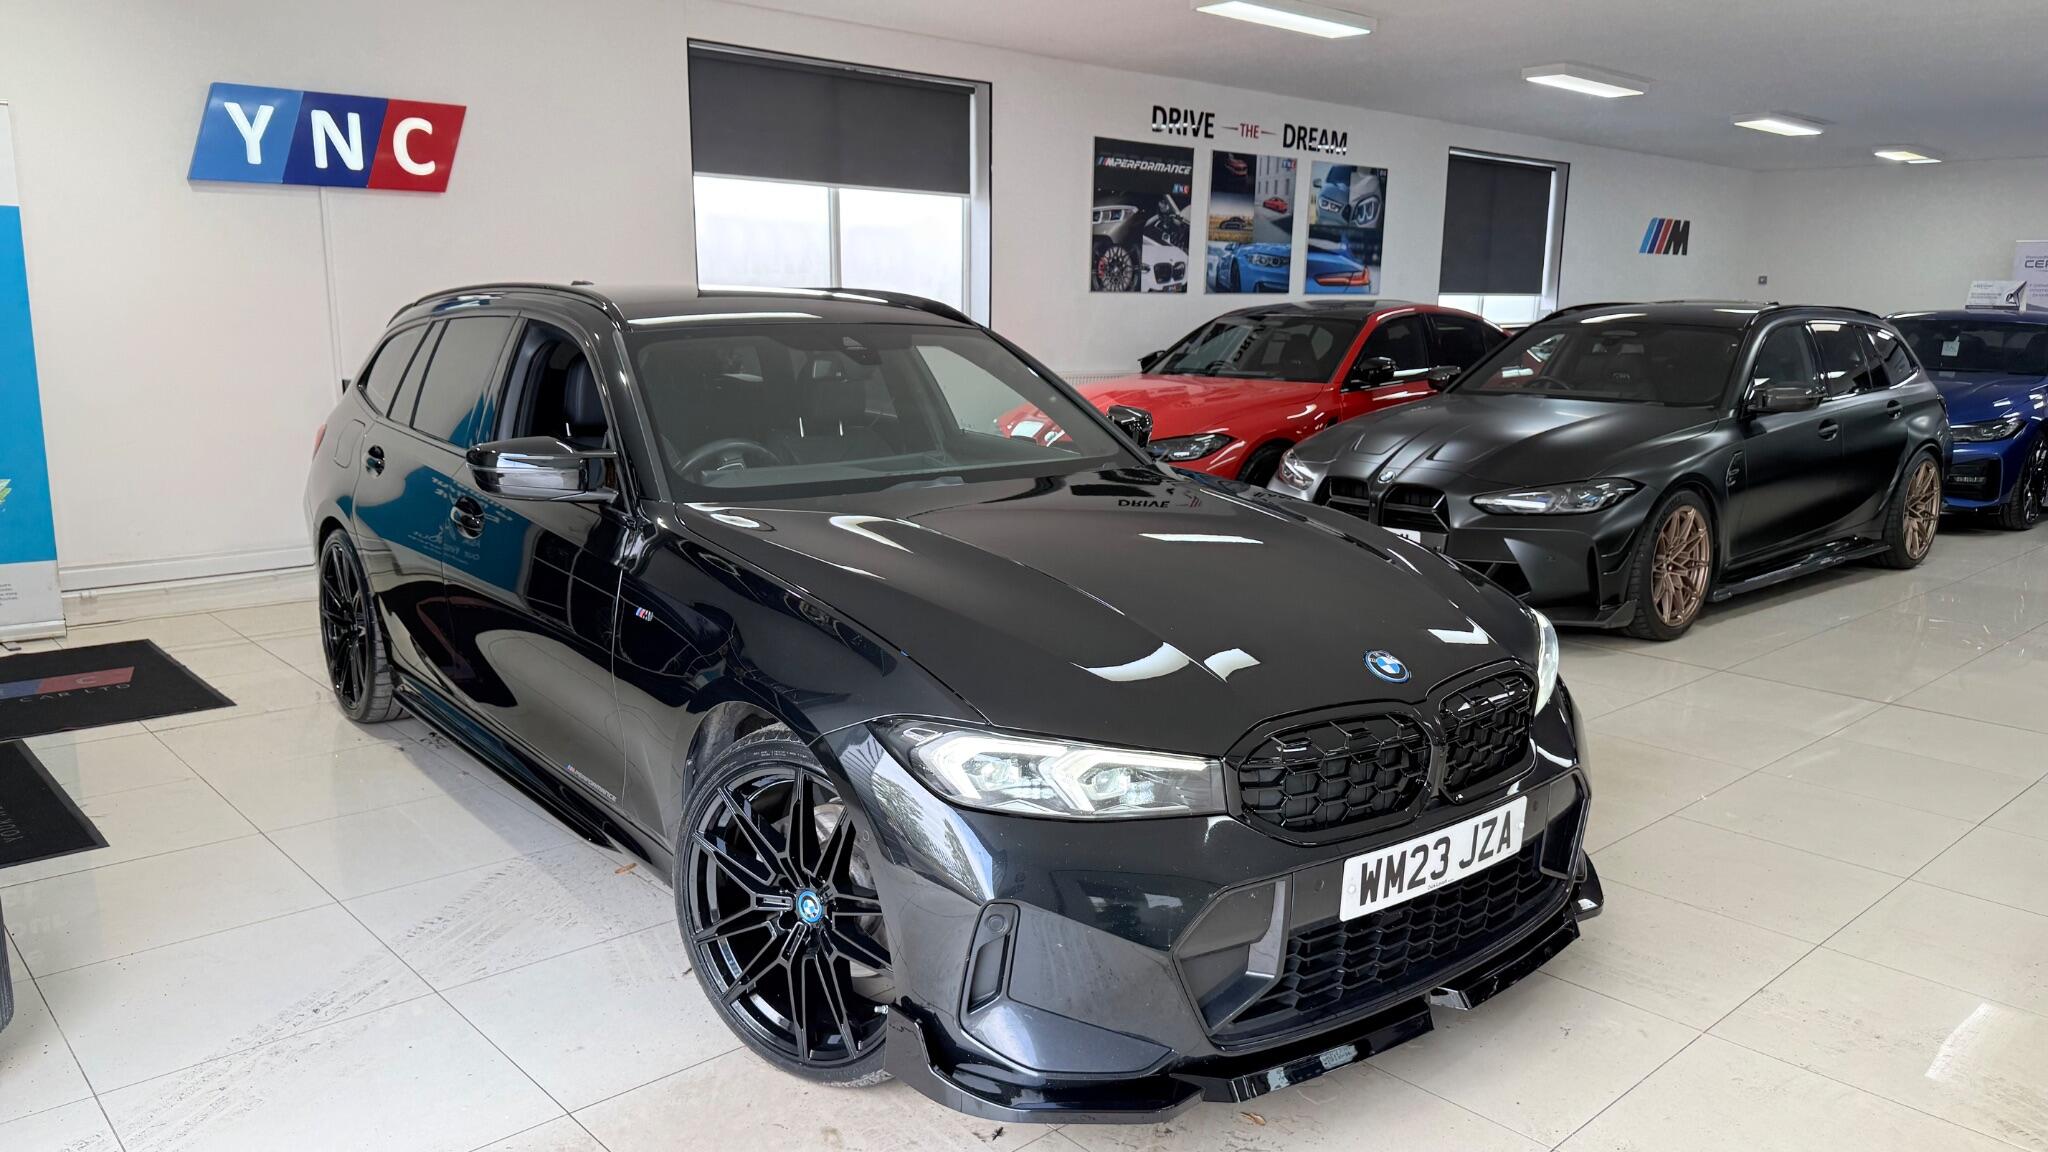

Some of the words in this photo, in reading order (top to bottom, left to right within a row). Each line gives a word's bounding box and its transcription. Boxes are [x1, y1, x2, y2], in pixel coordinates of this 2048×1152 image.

[223, 101, 436, 176] YNC
[1151, 105, 1216, 139] DRIVE
[1239, 122, 1260, 139] THE
[1282, 123, 1348, 156] DREAM
[1359, 836, 1451, 907] WM23
[1458, 809, 1512, 870] JZA
